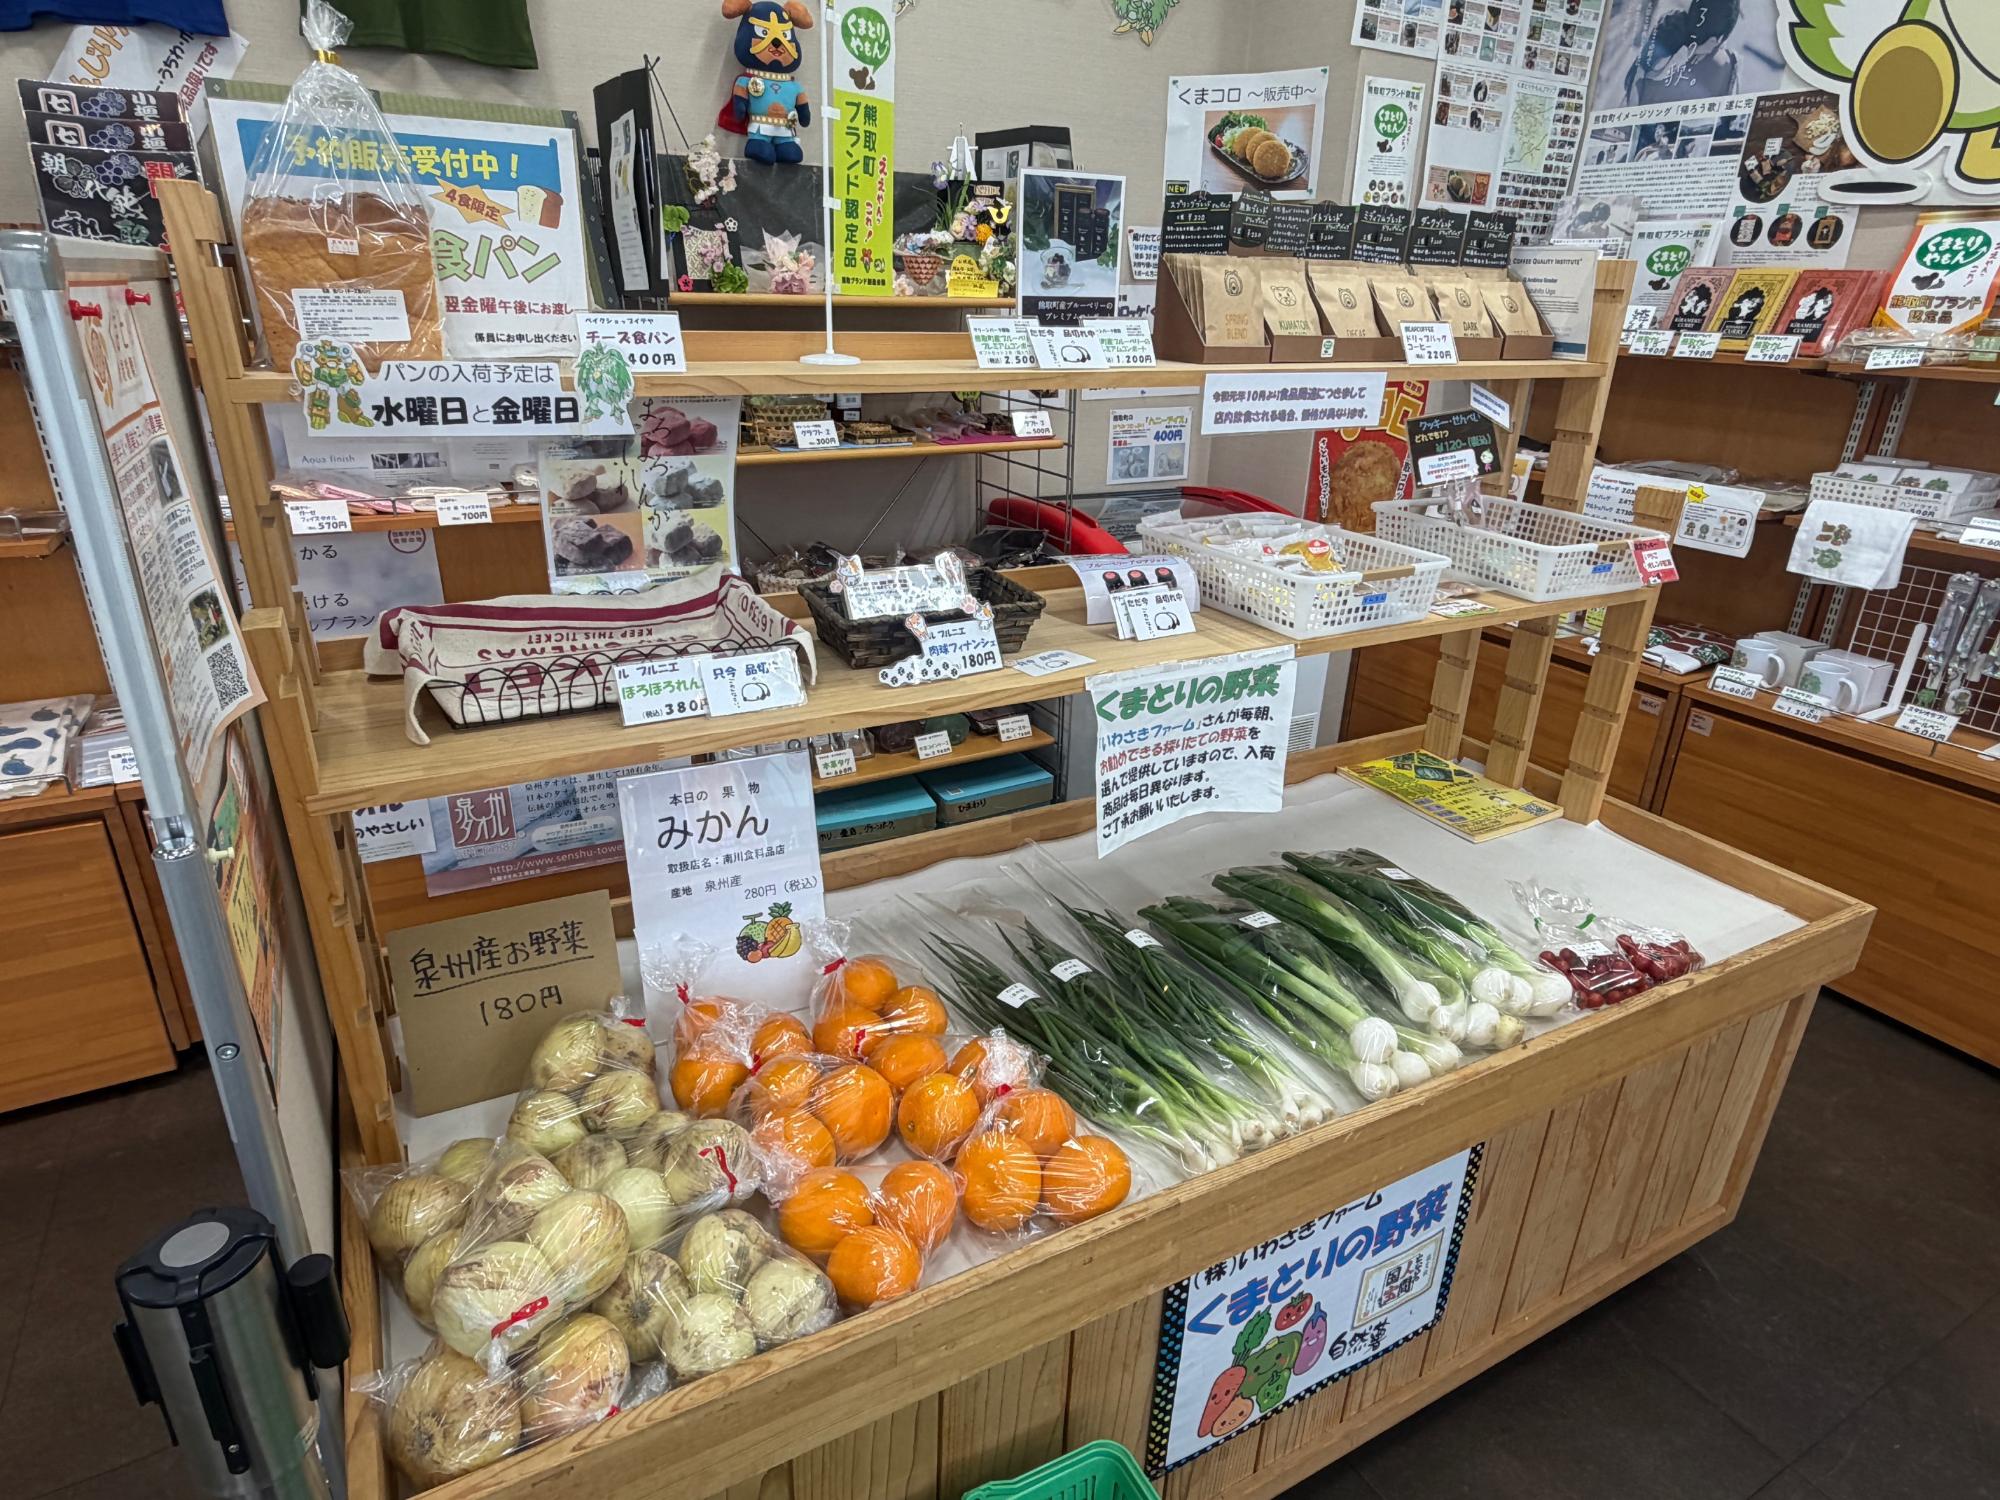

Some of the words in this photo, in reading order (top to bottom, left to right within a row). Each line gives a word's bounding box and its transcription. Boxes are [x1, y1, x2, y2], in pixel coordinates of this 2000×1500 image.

[1178, 87, 1242, 105] くまコロ
[862, 103, 879, 178] 熊取町
[844, 100, 862, 268] ブランド認定品
[1167, 185, 1188, 193] NEW
[445, 189, 501, 222] 4食限定
[1927, 235, 1984, 252] くまとり
[1889, 294, 1983, 310] 熊取町ブランド
[1907, 309, 1954, 325] 認定品
[474, 331, 578, 345] 係員にお申し出ください
[585, 330, 676, 345] チーズ食パン
[1029, 328, 1056, 338] ただ今
[627, 353, 677, 366] 400円
[1427, 350, 1451, 360] 220円
[383, 362, 555, 385] パンの入荷予定は
[371, 395, 581, 427] 水曜日と金曜日
[1032, 427, 1051, 436] 500円
[1153, 429, 1183, 442] 400円
[815, 437, 837, 446] 300円
[461, 511, 488, 521] 700円
[318, 521, 348, 530] 570円
[301, 544, 339, 561] かる
[304, 592, 350, 610] ける
[526, 632, 579, 645] TICKET
[582, 631, 616, 642] THIS
[627, 627, 653, 639] KEEP
[928, 639, 997, 657] 肉球フィナンシェ
[636, 662, 679, 676] フルニエ
[961, 651, 997, 670] 180円
[712, 667, 738, 680] 只今
[622, 675, 700, 699] ほろほろれん
[1096, 663, 1282, 723] くまとりの野菜
[1101, 744, 1276, 798] 選んで提供していますので、入荷
[669, 790, 709, 807] 本日の
[722, 785, 736, 799] 果
[747, 781, 761, 795] 物
[1102, 769, 1211, 820] 商品は毎日異なります。
[656, 804, 770, 851] みかん
[667, 843, 786, 874] 取扱店名：南川食料品店
[670, 885, 693, 899] 産地
[704, 874, 743, 893] 泉州産
[744, 884, 777, 901] 280円
[409, 919, 589, 991] 泉州産お野菜
[479, 984, 563, 1027] 180円
[1186, 1180, 1453, 1337] くまとりの野菜
